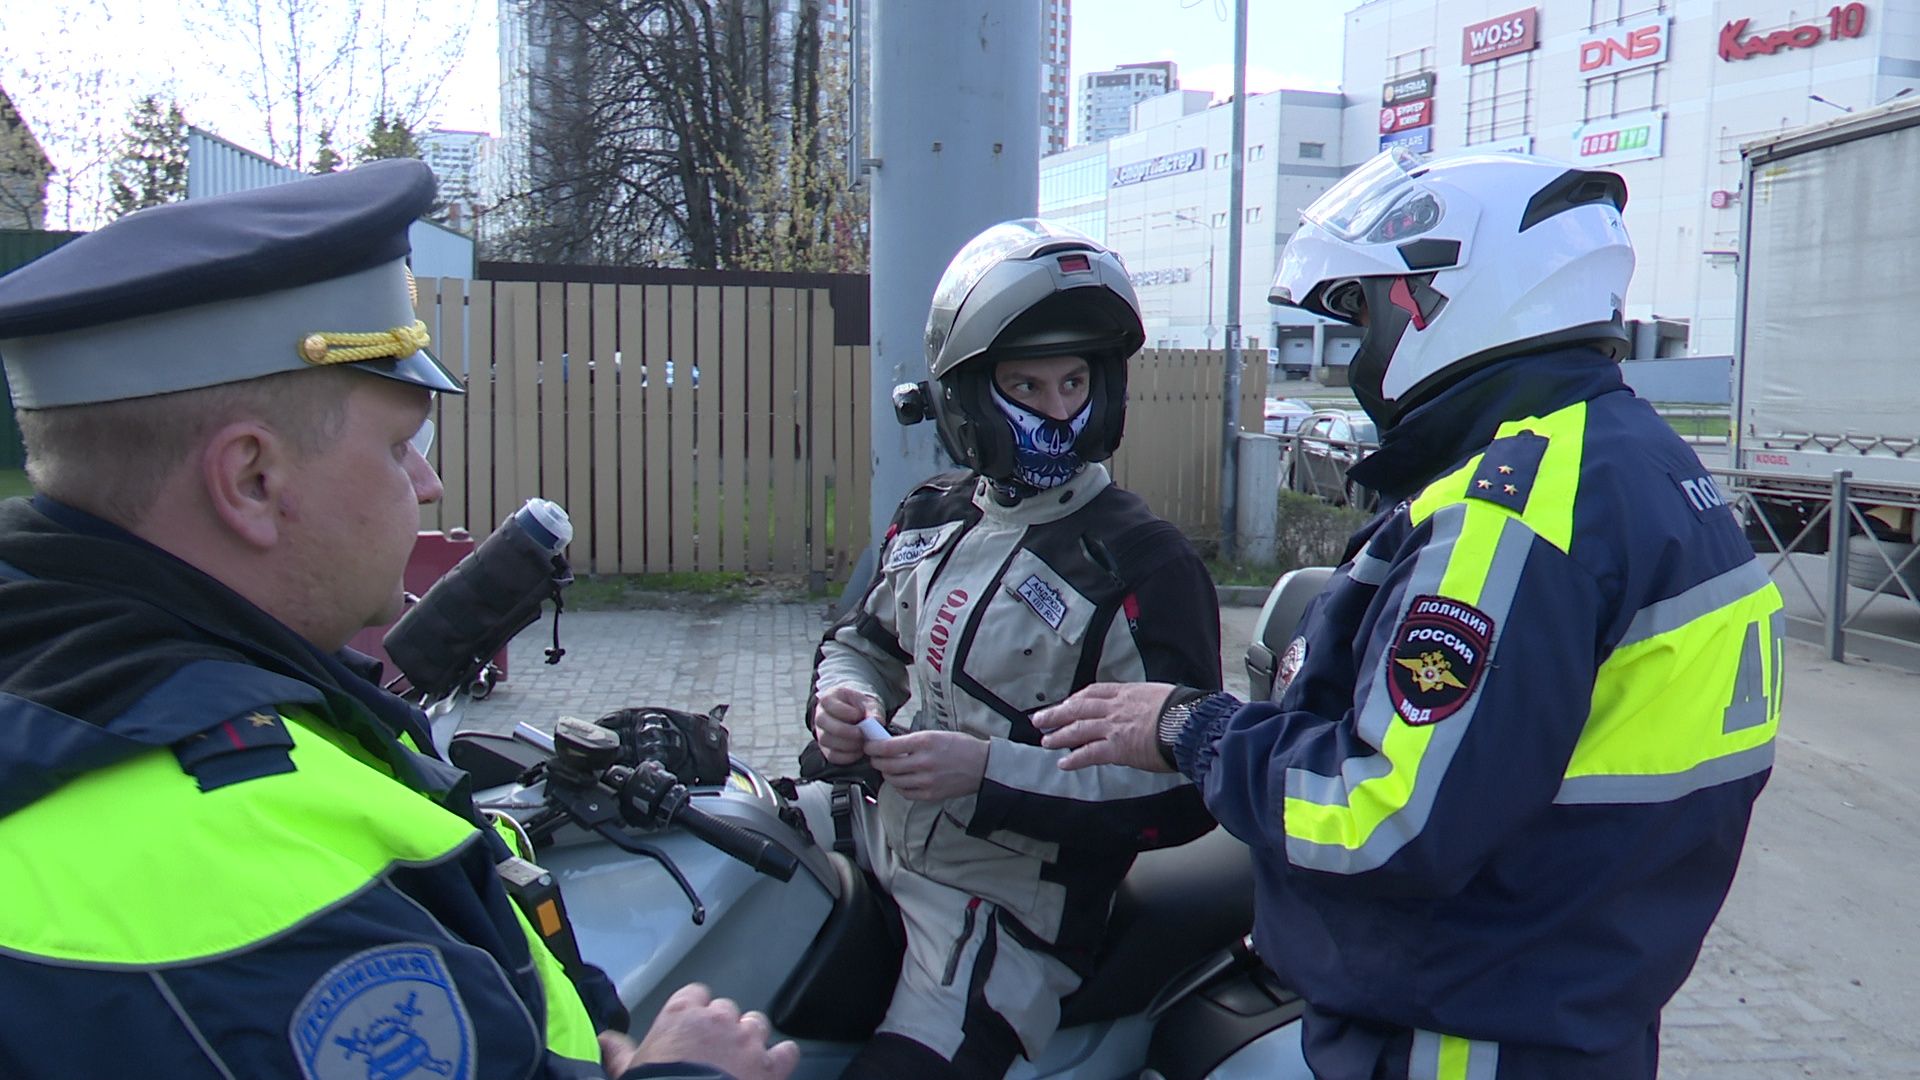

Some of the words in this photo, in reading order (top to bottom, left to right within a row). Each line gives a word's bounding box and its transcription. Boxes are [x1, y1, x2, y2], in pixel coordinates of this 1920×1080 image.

[1470, 17, 1525, 49] WOSS
[1826, 2, 1866, 40] 10
[1580, 25, 1661, 72] DNS
[1680, 475, 1726, 511] ПО
[1417, 601, 1489, 636] ПОЛИЦИЯ
[1407, 628, 1475, 665] РОССИЯ
[1400, 698, 1432, 722] МВД
